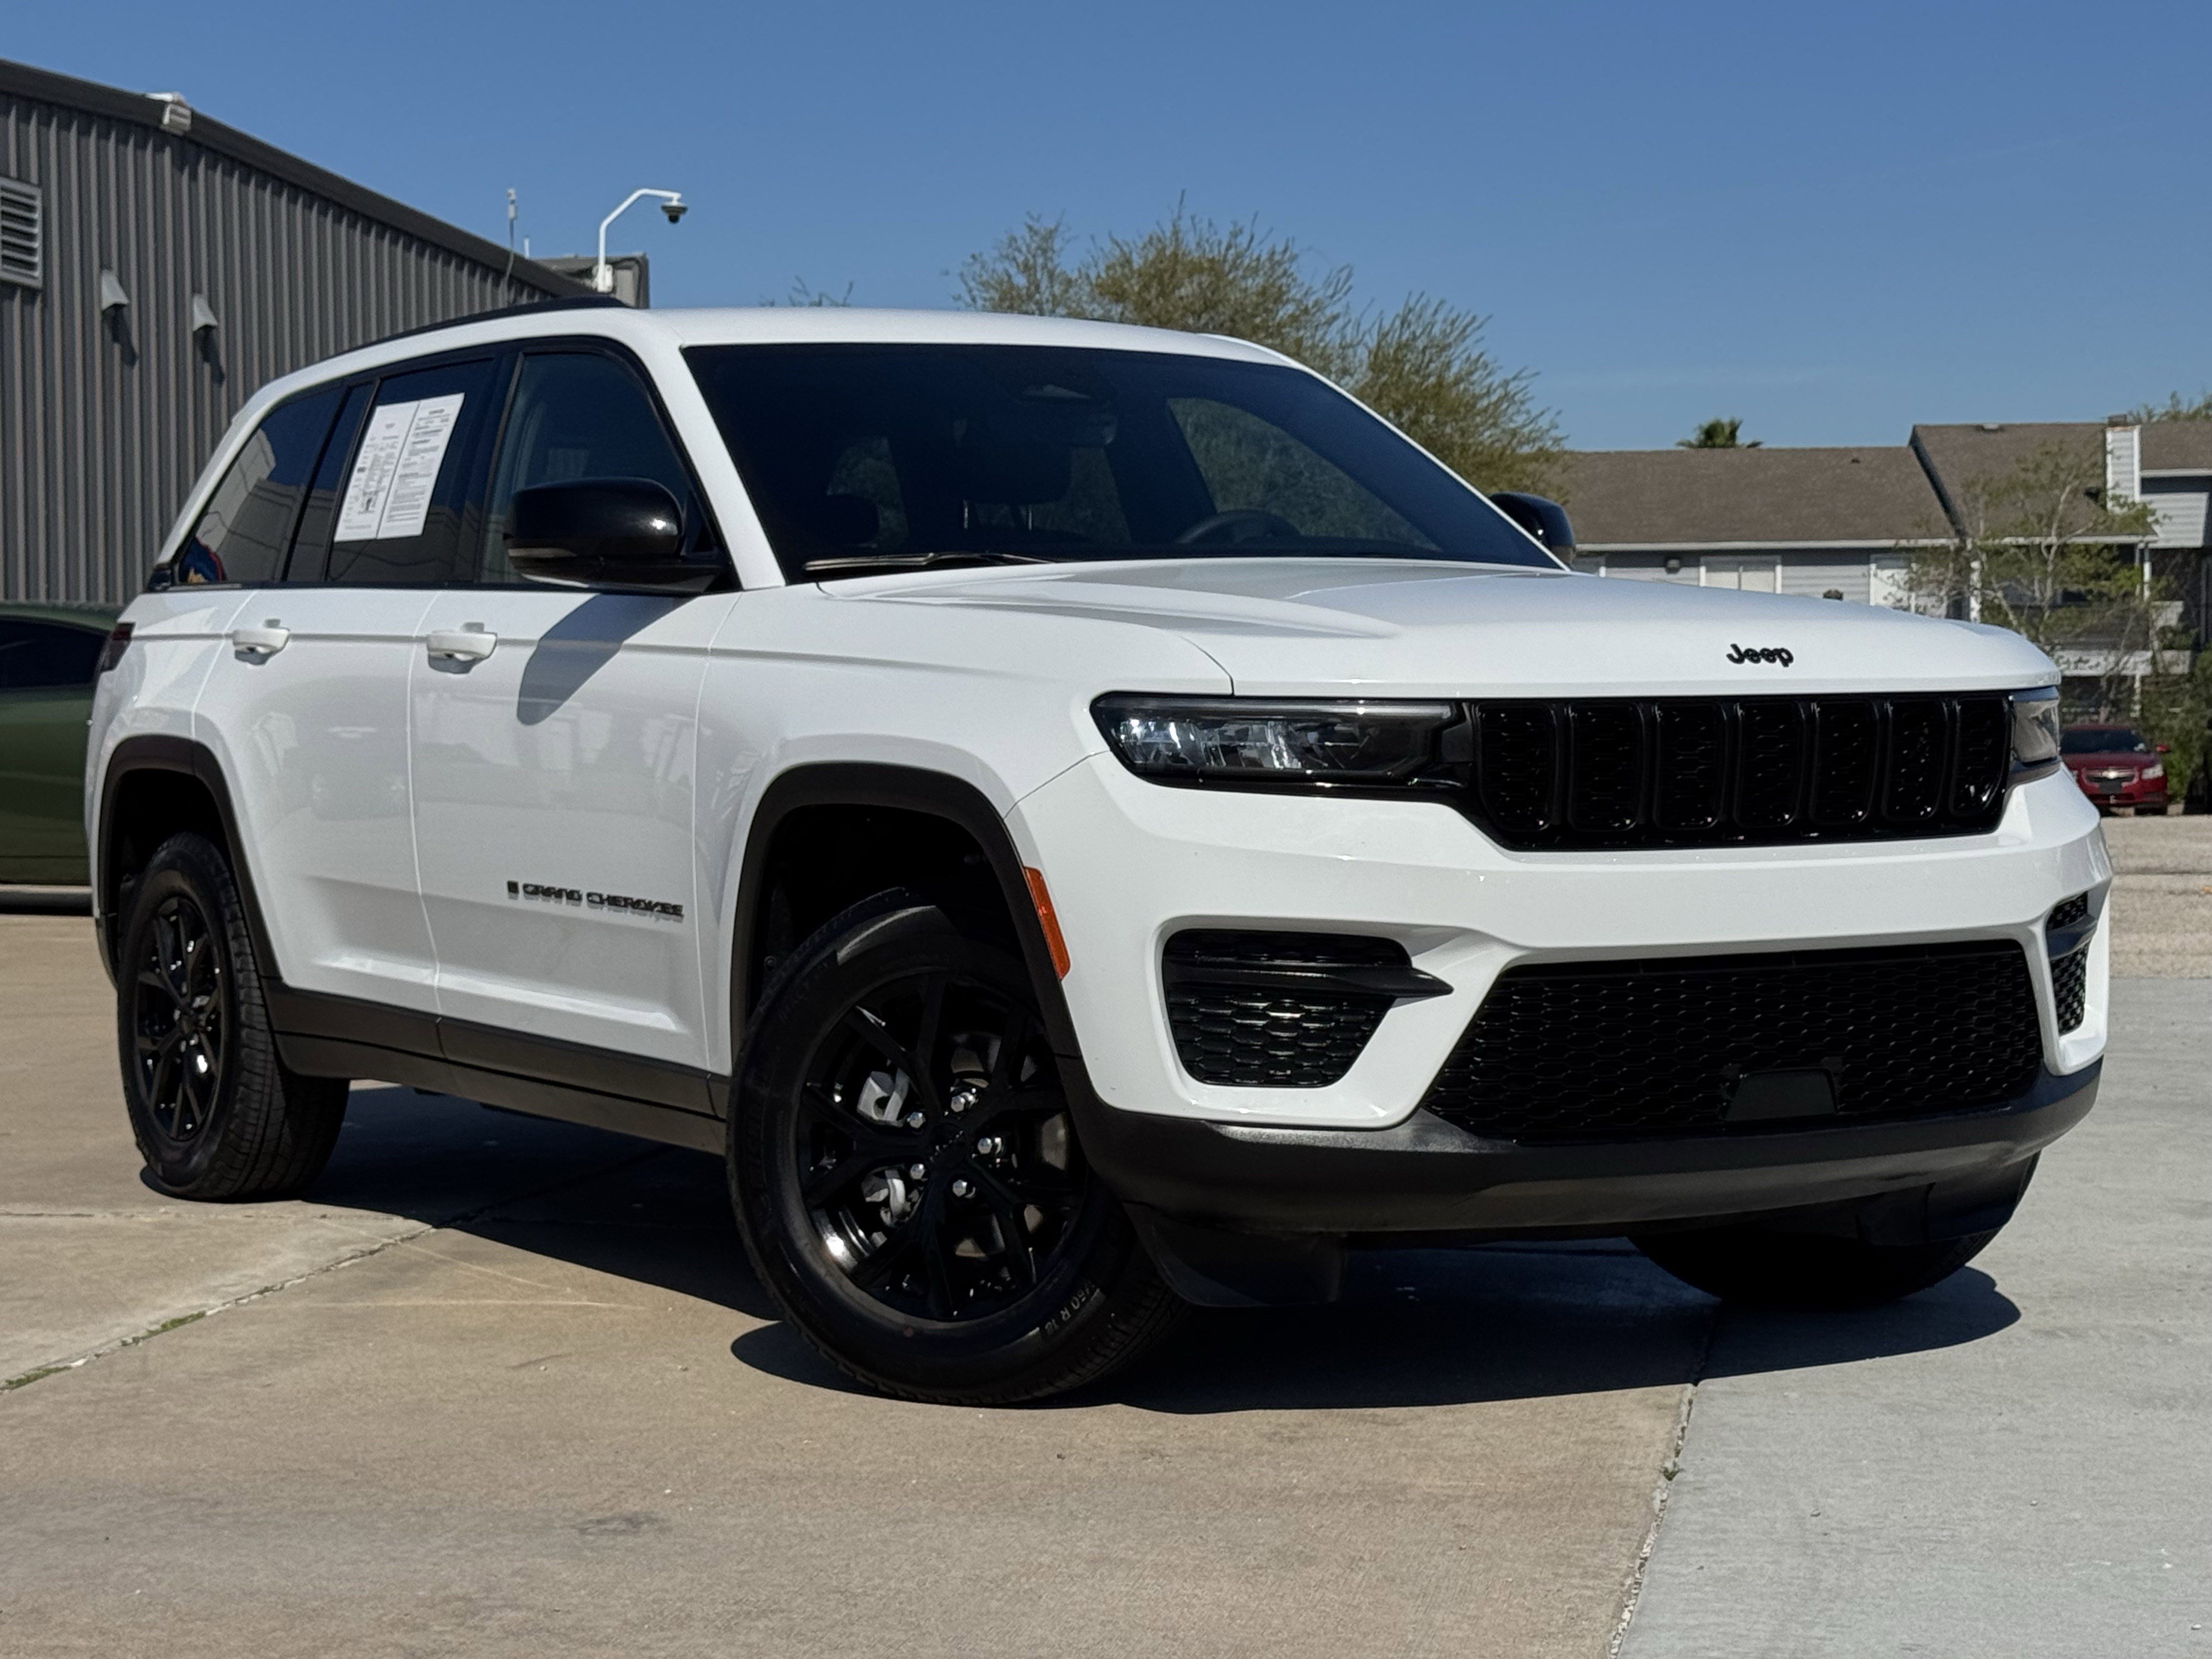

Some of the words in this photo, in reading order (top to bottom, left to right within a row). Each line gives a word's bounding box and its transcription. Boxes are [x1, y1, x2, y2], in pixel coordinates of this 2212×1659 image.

[1726, 644, 1794, 667] Jeep
[523, 883, 583, 901] GRAND
[586, 892, 684, 917] CHEROKEE
